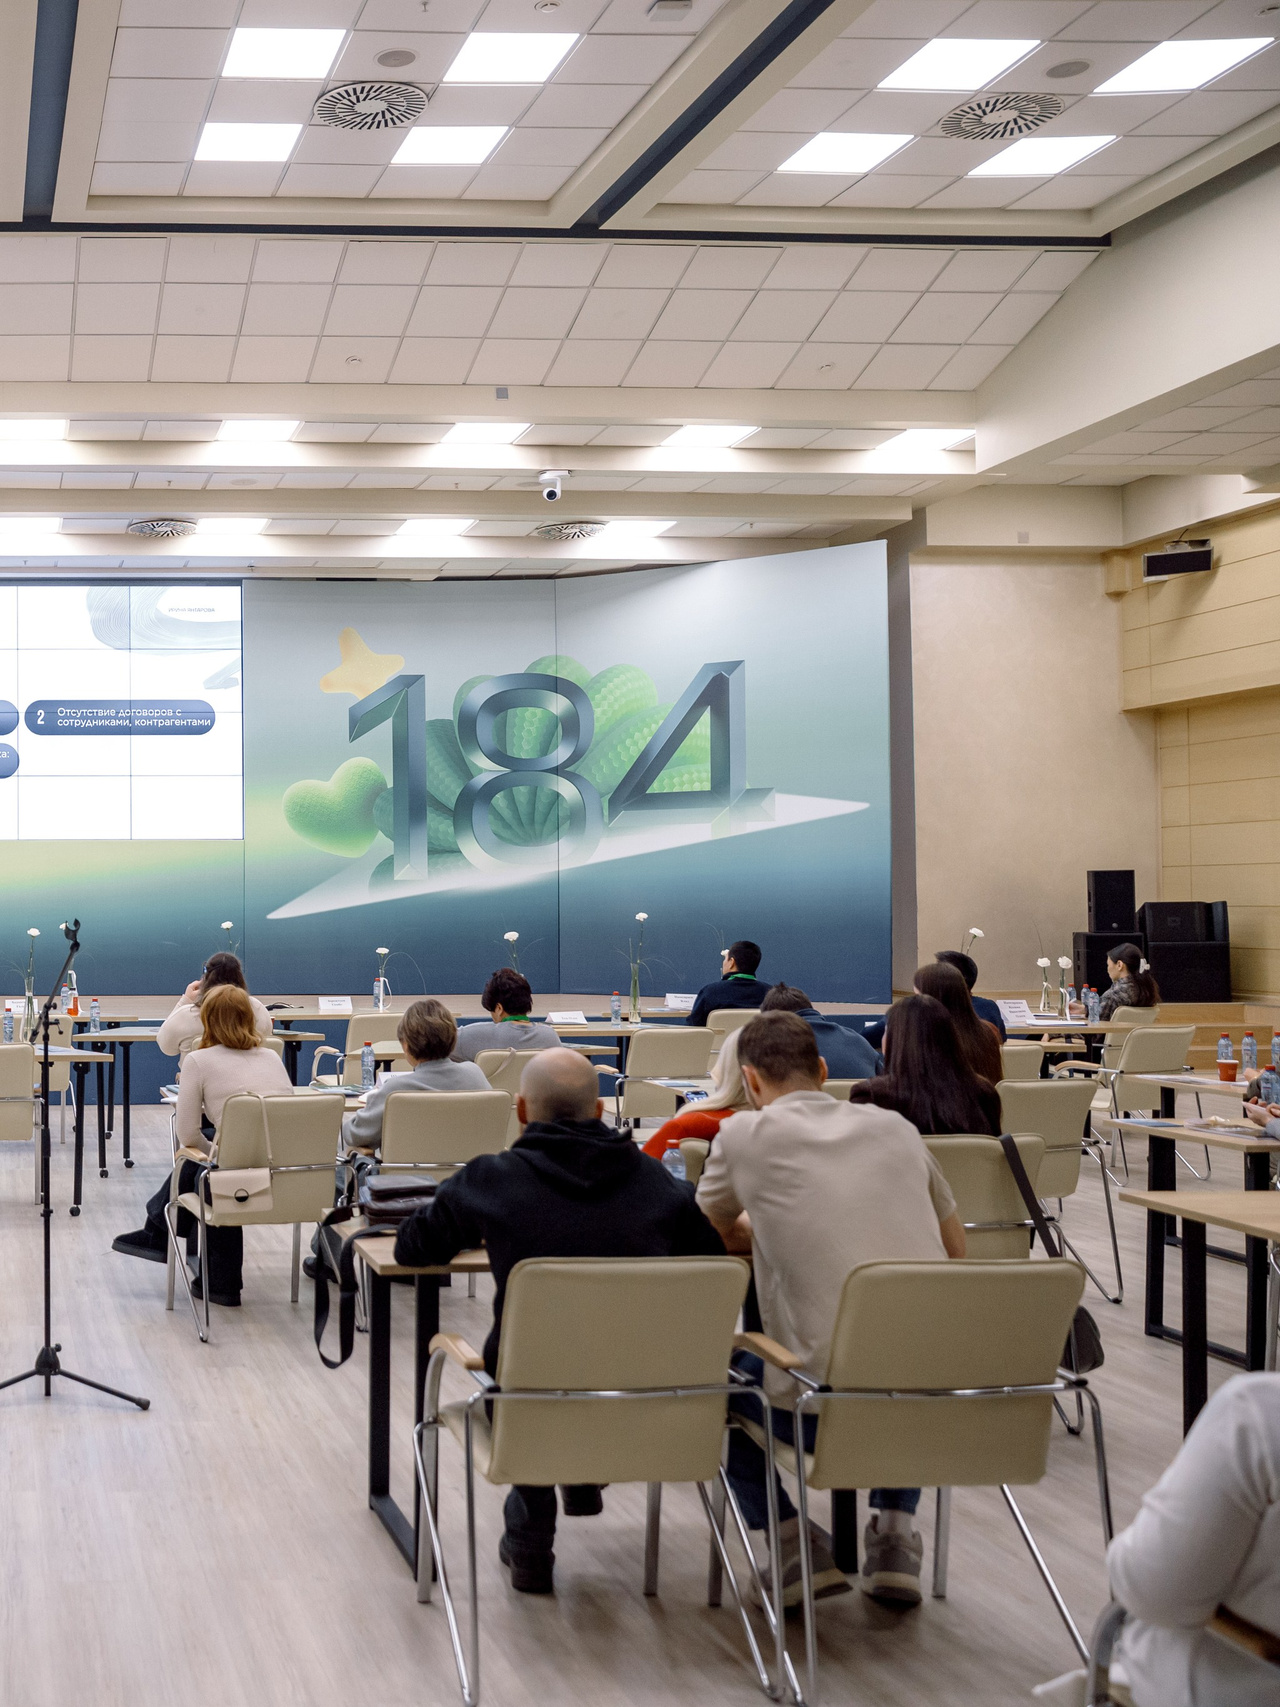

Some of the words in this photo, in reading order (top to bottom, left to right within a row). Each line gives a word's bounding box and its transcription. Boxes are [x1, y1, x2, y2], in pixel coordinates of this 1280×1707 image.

[36, 709, 45, 725] 2
[57, 707, 116, 717] Отсутствие
[118, 708, 173, 718] договоров
[57, 717, 132, 727] сотрудниками,
[134, 717, 211, 727] контрагентами
[348, 659, 776, 882] 184
